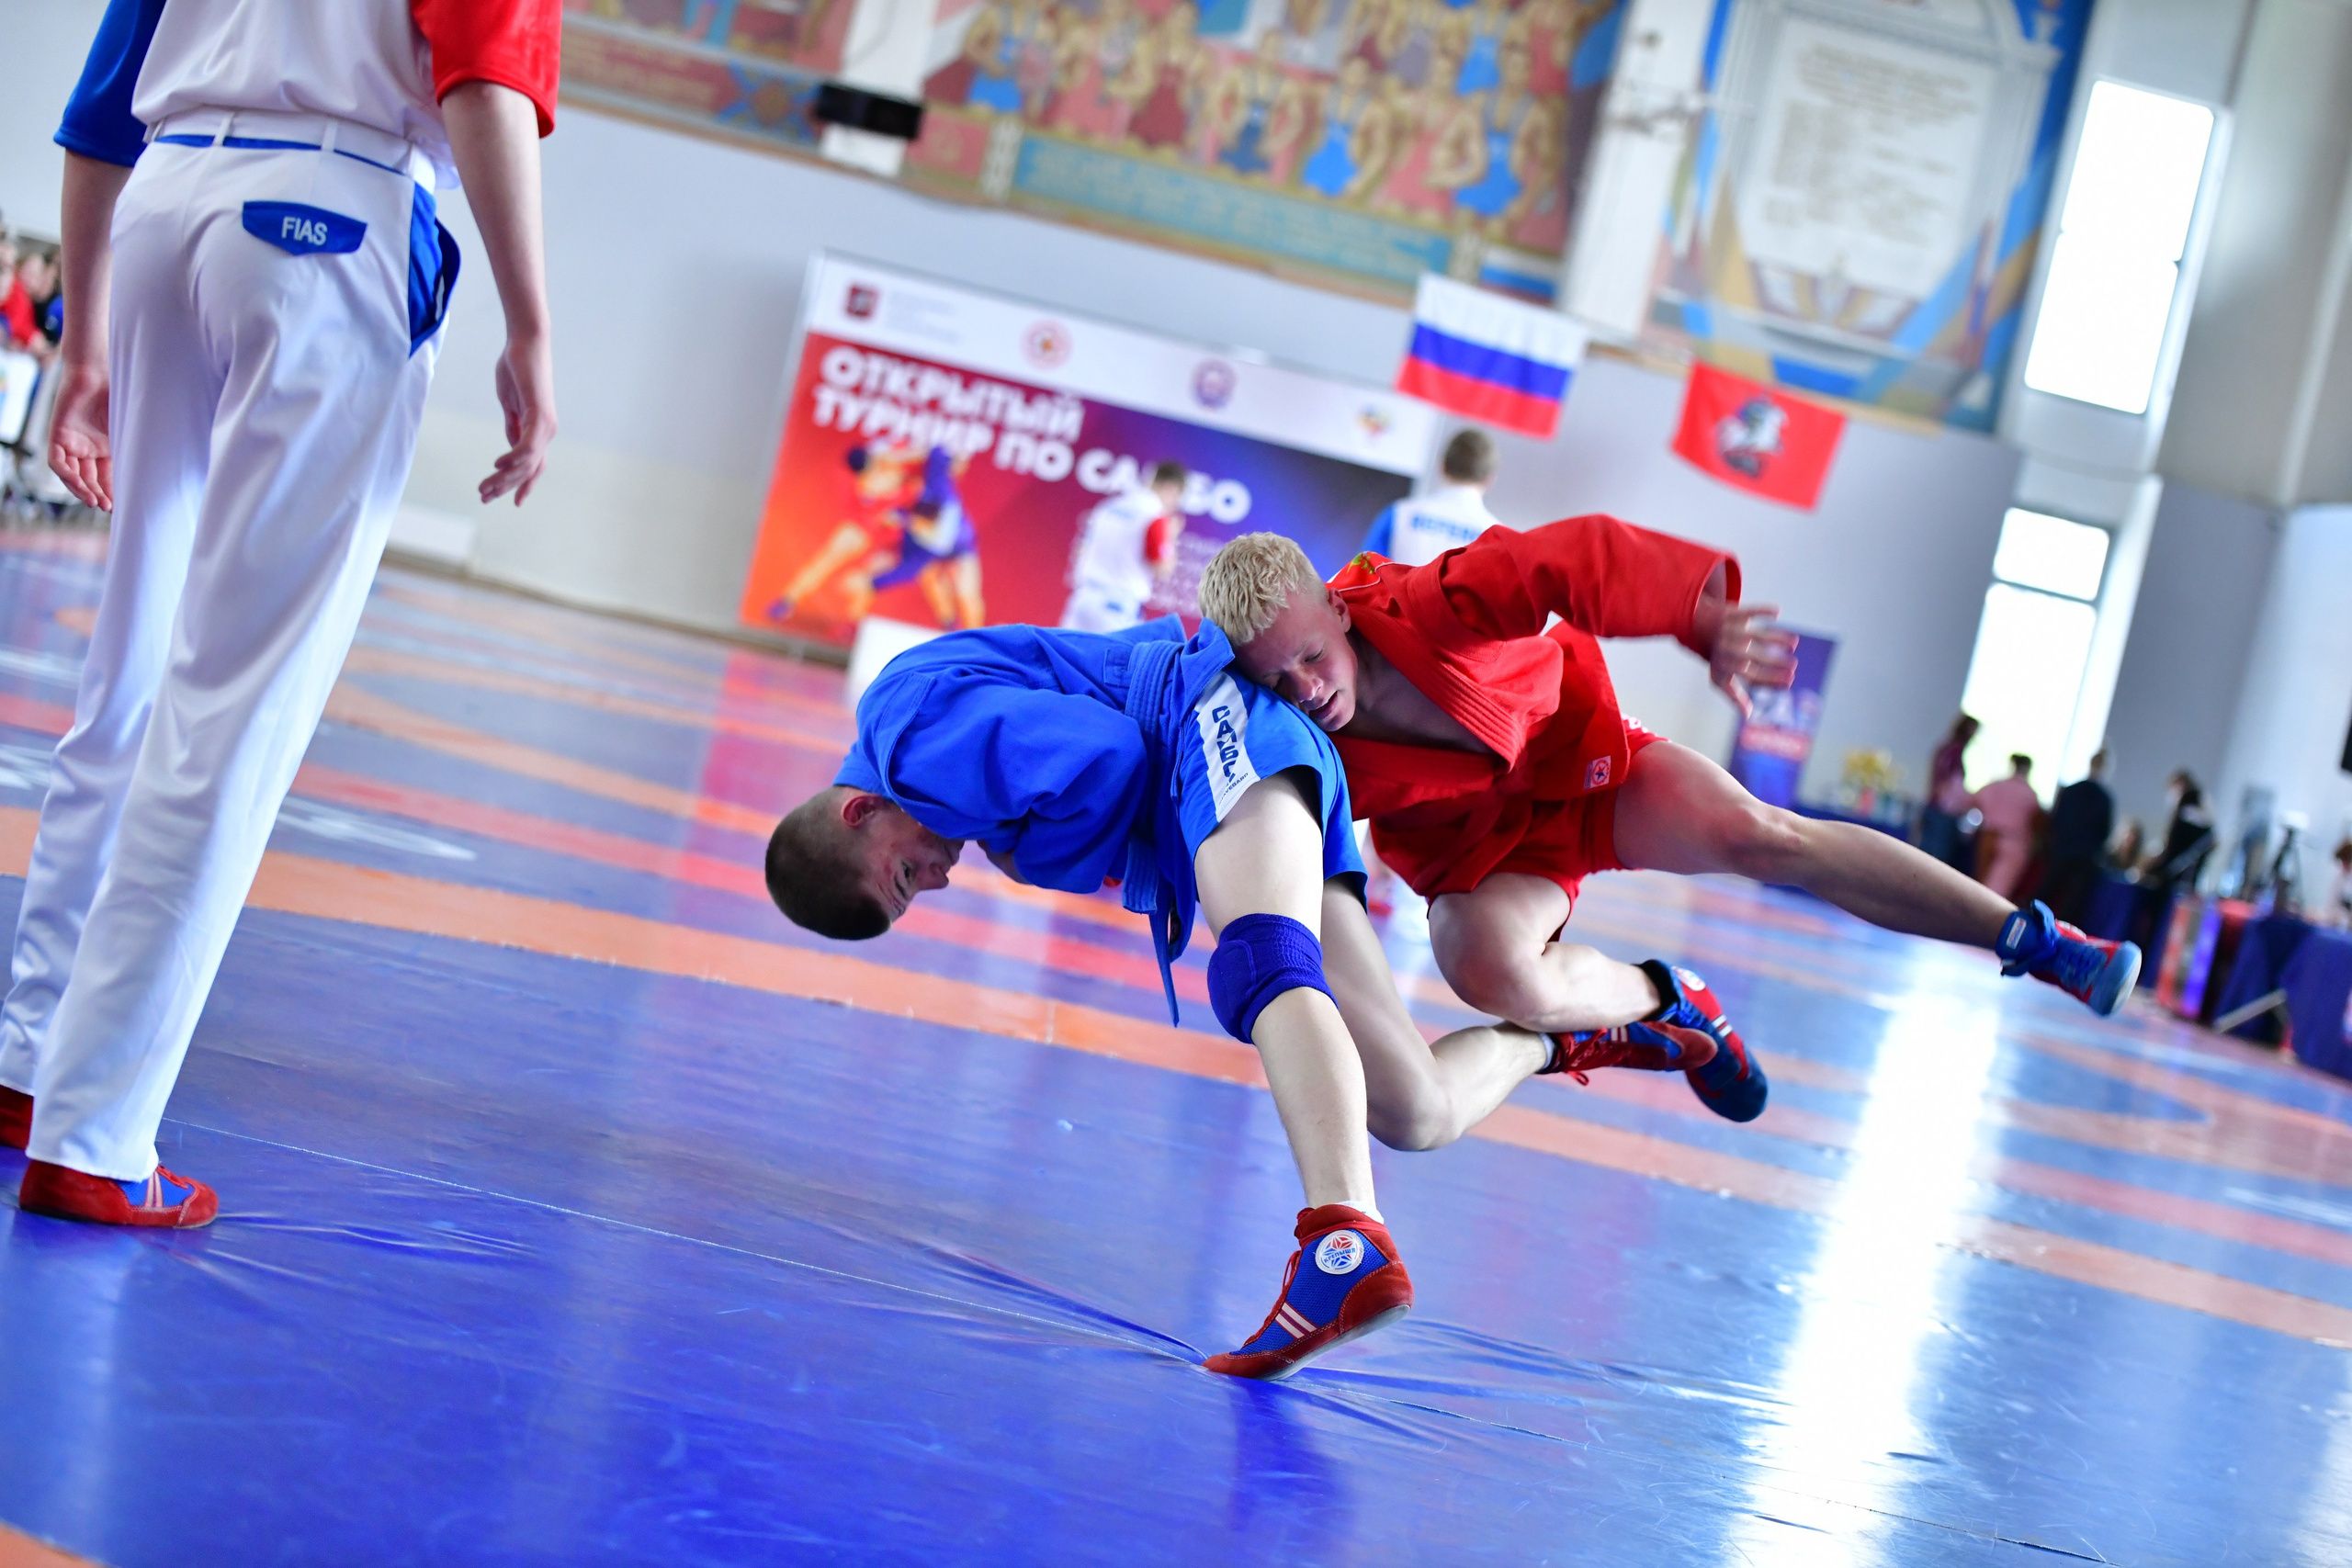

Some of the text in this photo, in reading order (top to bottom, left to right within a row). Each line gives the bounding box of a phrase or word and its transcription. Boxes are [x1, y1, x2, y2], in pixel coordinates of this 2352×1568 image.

[281, 215, 328, 246] FIAS
[820, 344, 1086, 444] ОТКРЫТЫЙ
[992, 431, 1076, 482] ПО
[1075, 447, 1252, 525] САБО
